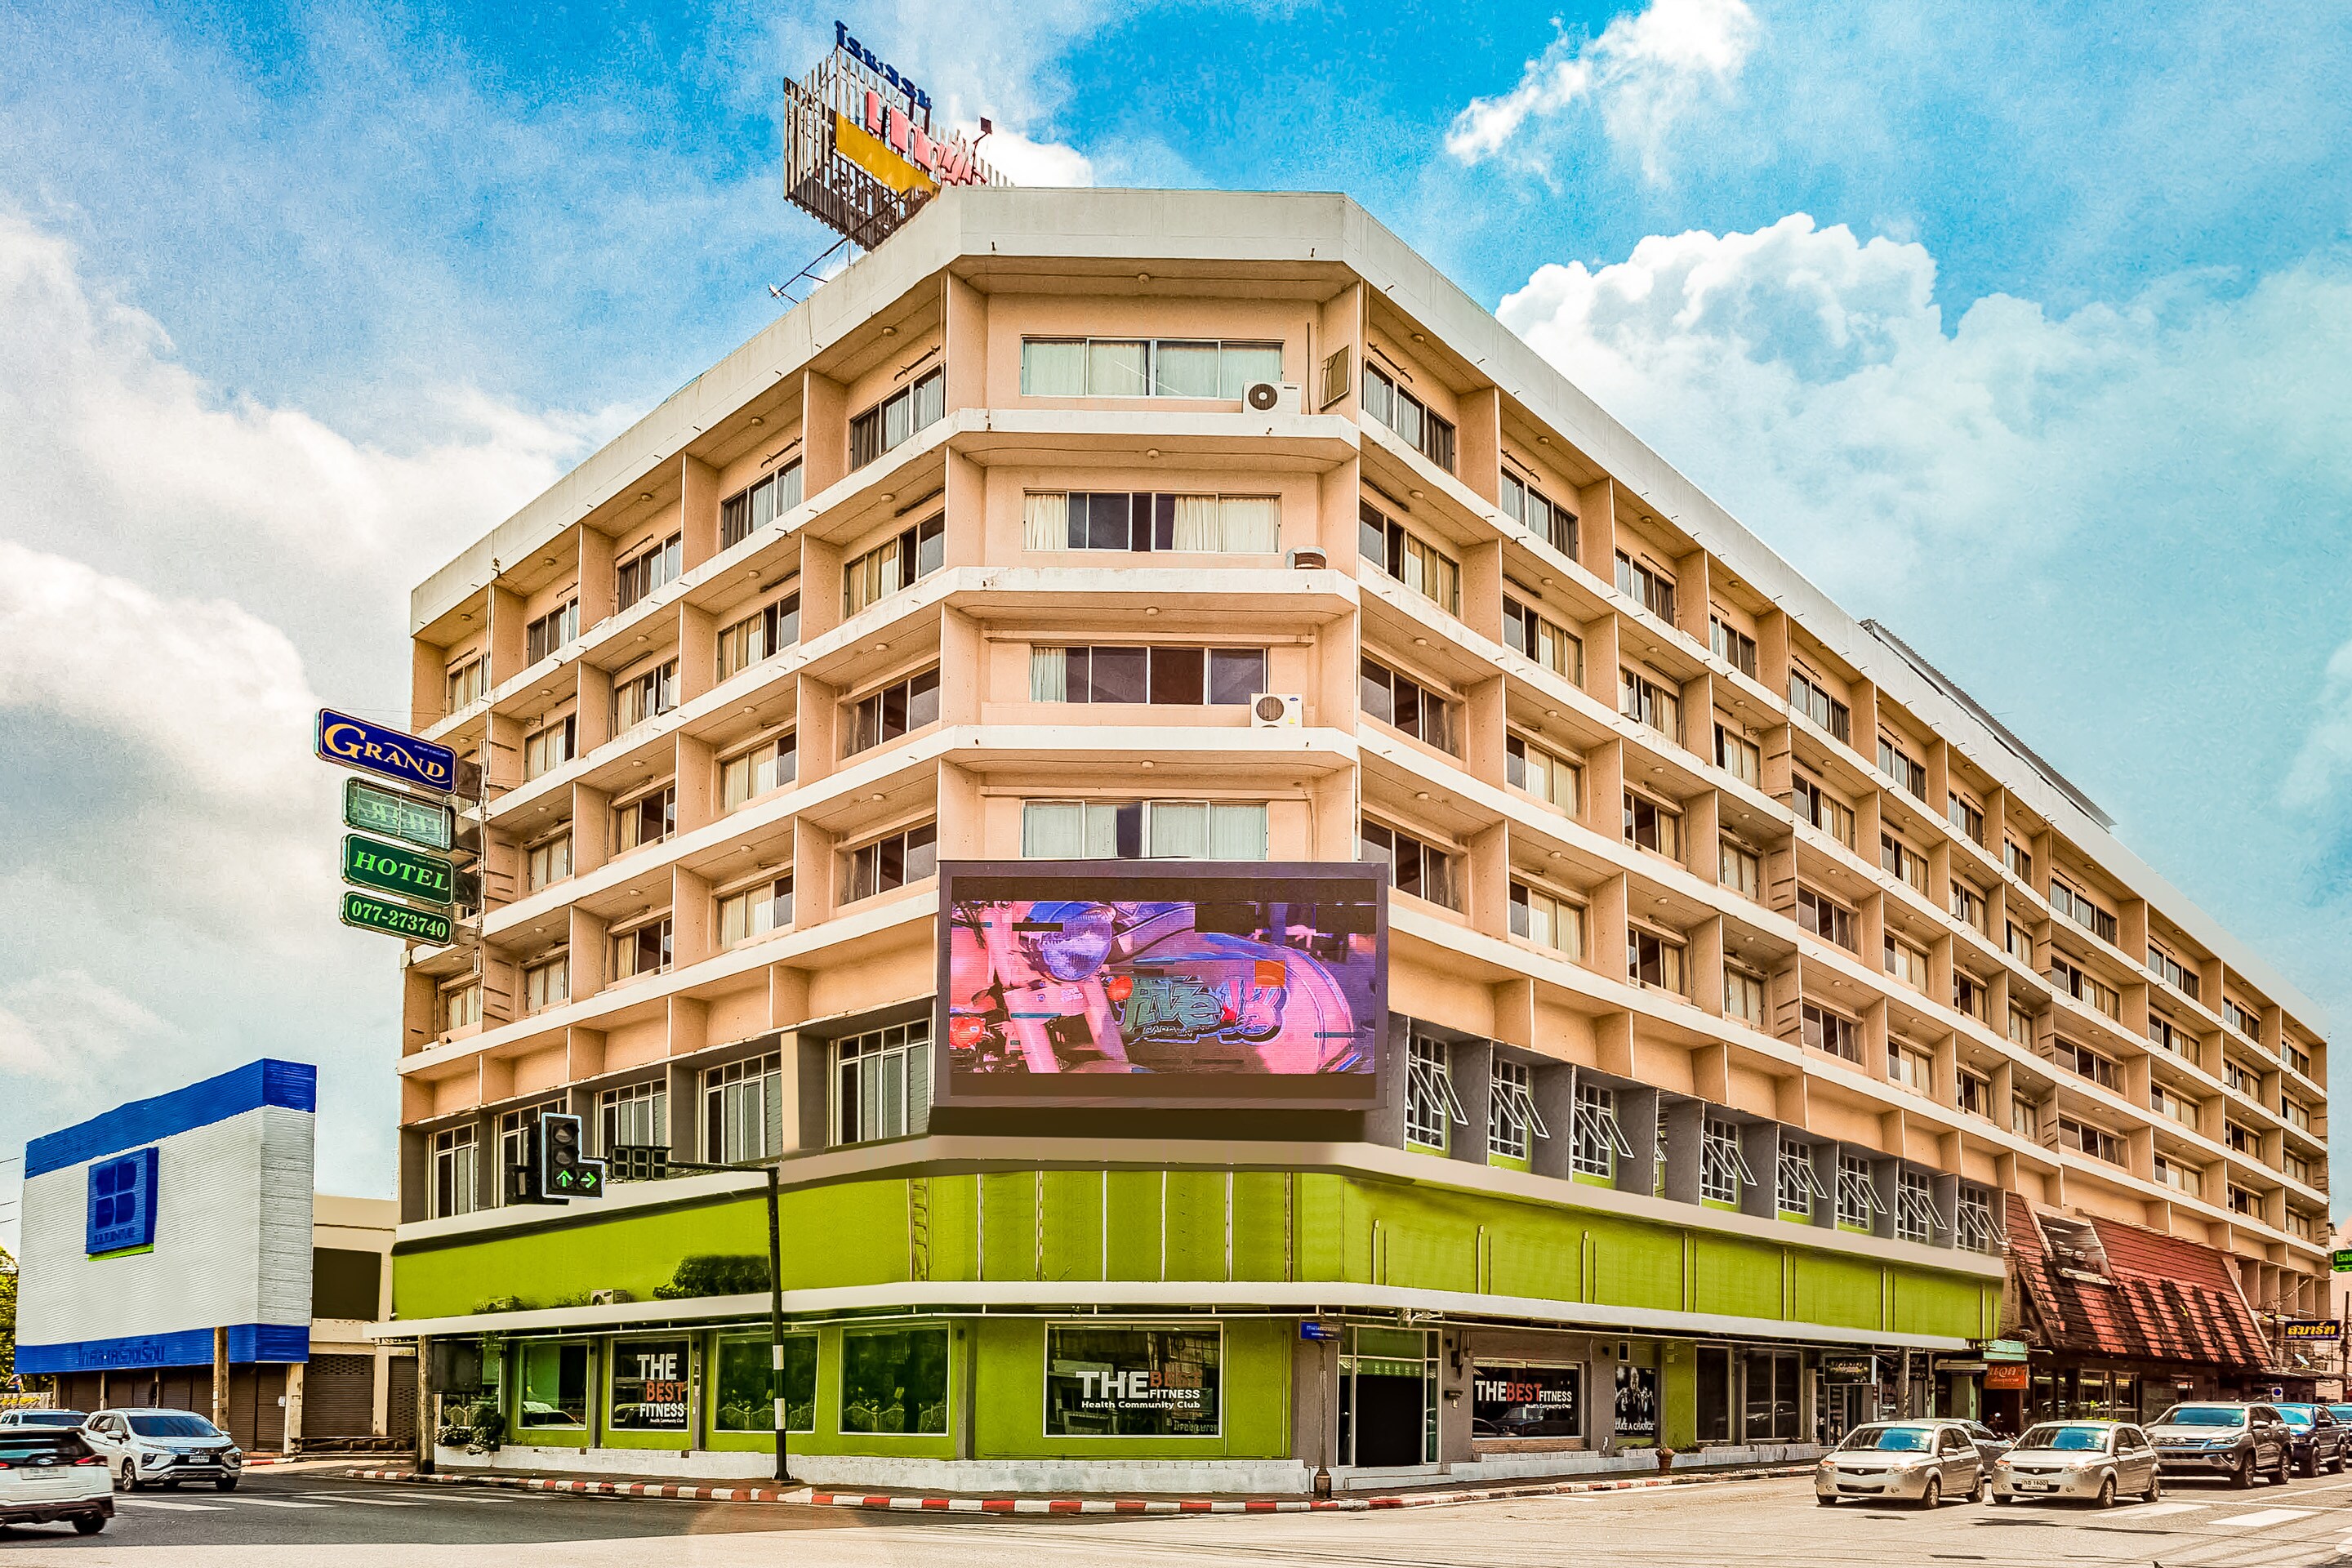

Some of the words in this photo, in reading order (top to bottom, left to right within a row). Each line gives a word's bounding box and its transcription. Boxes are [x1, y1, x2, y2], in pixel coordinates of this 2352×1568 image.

[324, 723, 450, 783] GRAND
[354, 851, 449, 891] HOTEL
[351, 901, 447, 938] 077-273740
[2287, 1321, 2336, 1335] สมาร์ท
[637, 1353, 677, 1380] THE
[646, 1381, 684, 1401] BEST
[1076, 1371, 1149, 1398] THE
[1149, 1389, 1200, 1399] FITNESS
[1475, 1380, 1507, 1401] THE
[1507, 1382, 1542, 1401] BEST
[1539, 1390, 1572, 1402] FITNESS
[639, 1403, 684, 1417] FITNESS
[1118, 1401, 1174, 1410] Community
